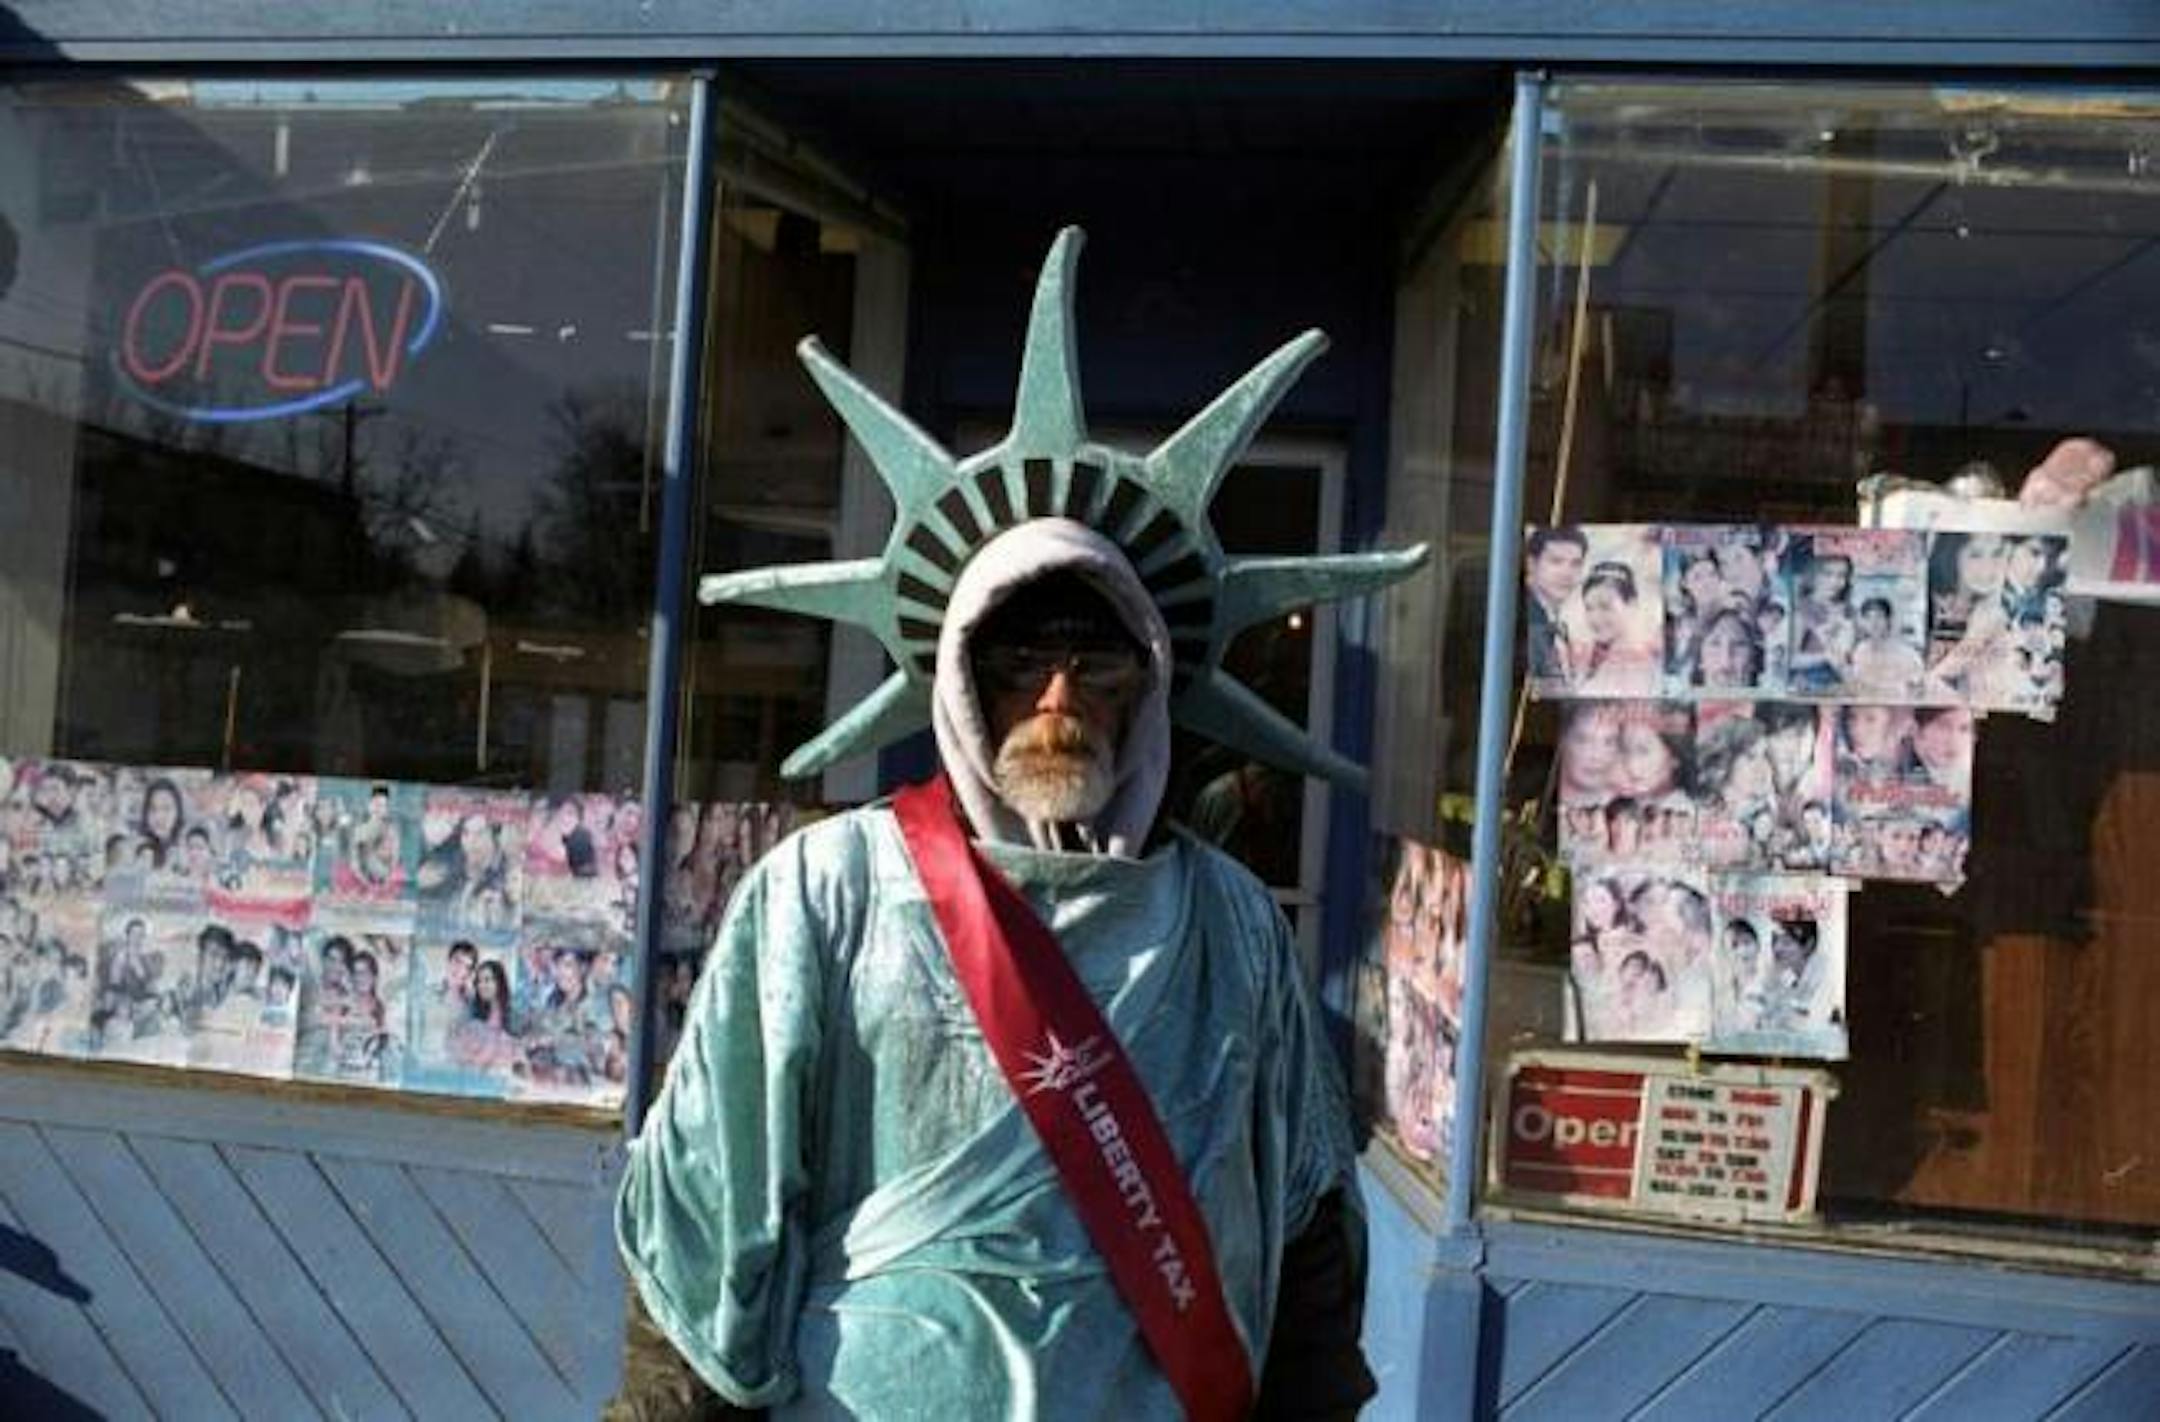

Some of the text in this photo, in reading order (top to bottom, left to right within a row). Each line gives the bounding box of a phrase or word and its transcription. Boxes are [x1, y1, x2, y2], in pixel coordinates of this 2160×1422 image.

[121, 268, 416, 394] OPEN
[1073, 1084, 1197, 1311] LIBERTY TAX
